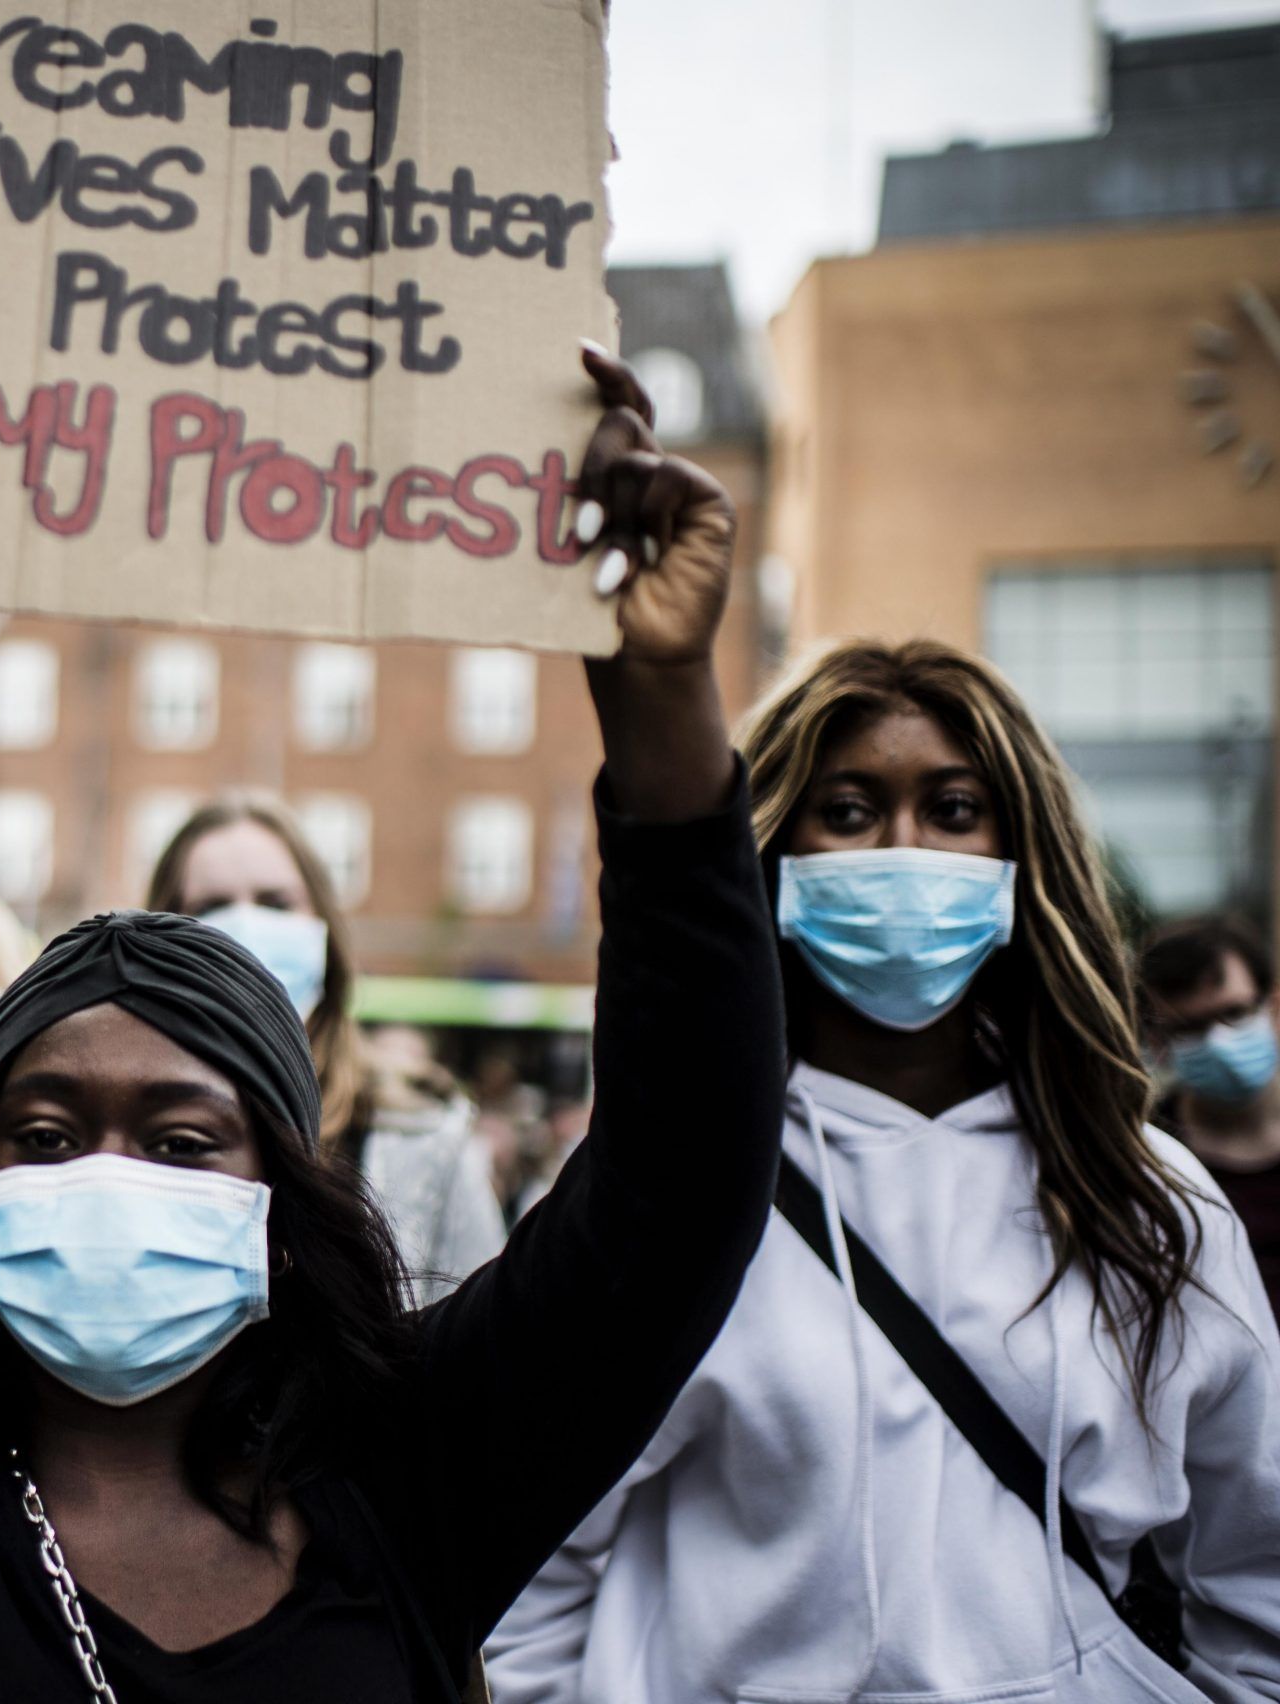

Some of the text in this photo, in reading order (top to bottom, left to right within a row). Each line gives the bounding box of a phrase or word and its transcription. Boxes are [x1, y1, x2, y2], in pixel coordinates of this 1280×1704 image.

[249, 158, 595, 270] Matter
[48, 250, 462, 383] Protest
[147, 392, 584, 566] Protest
